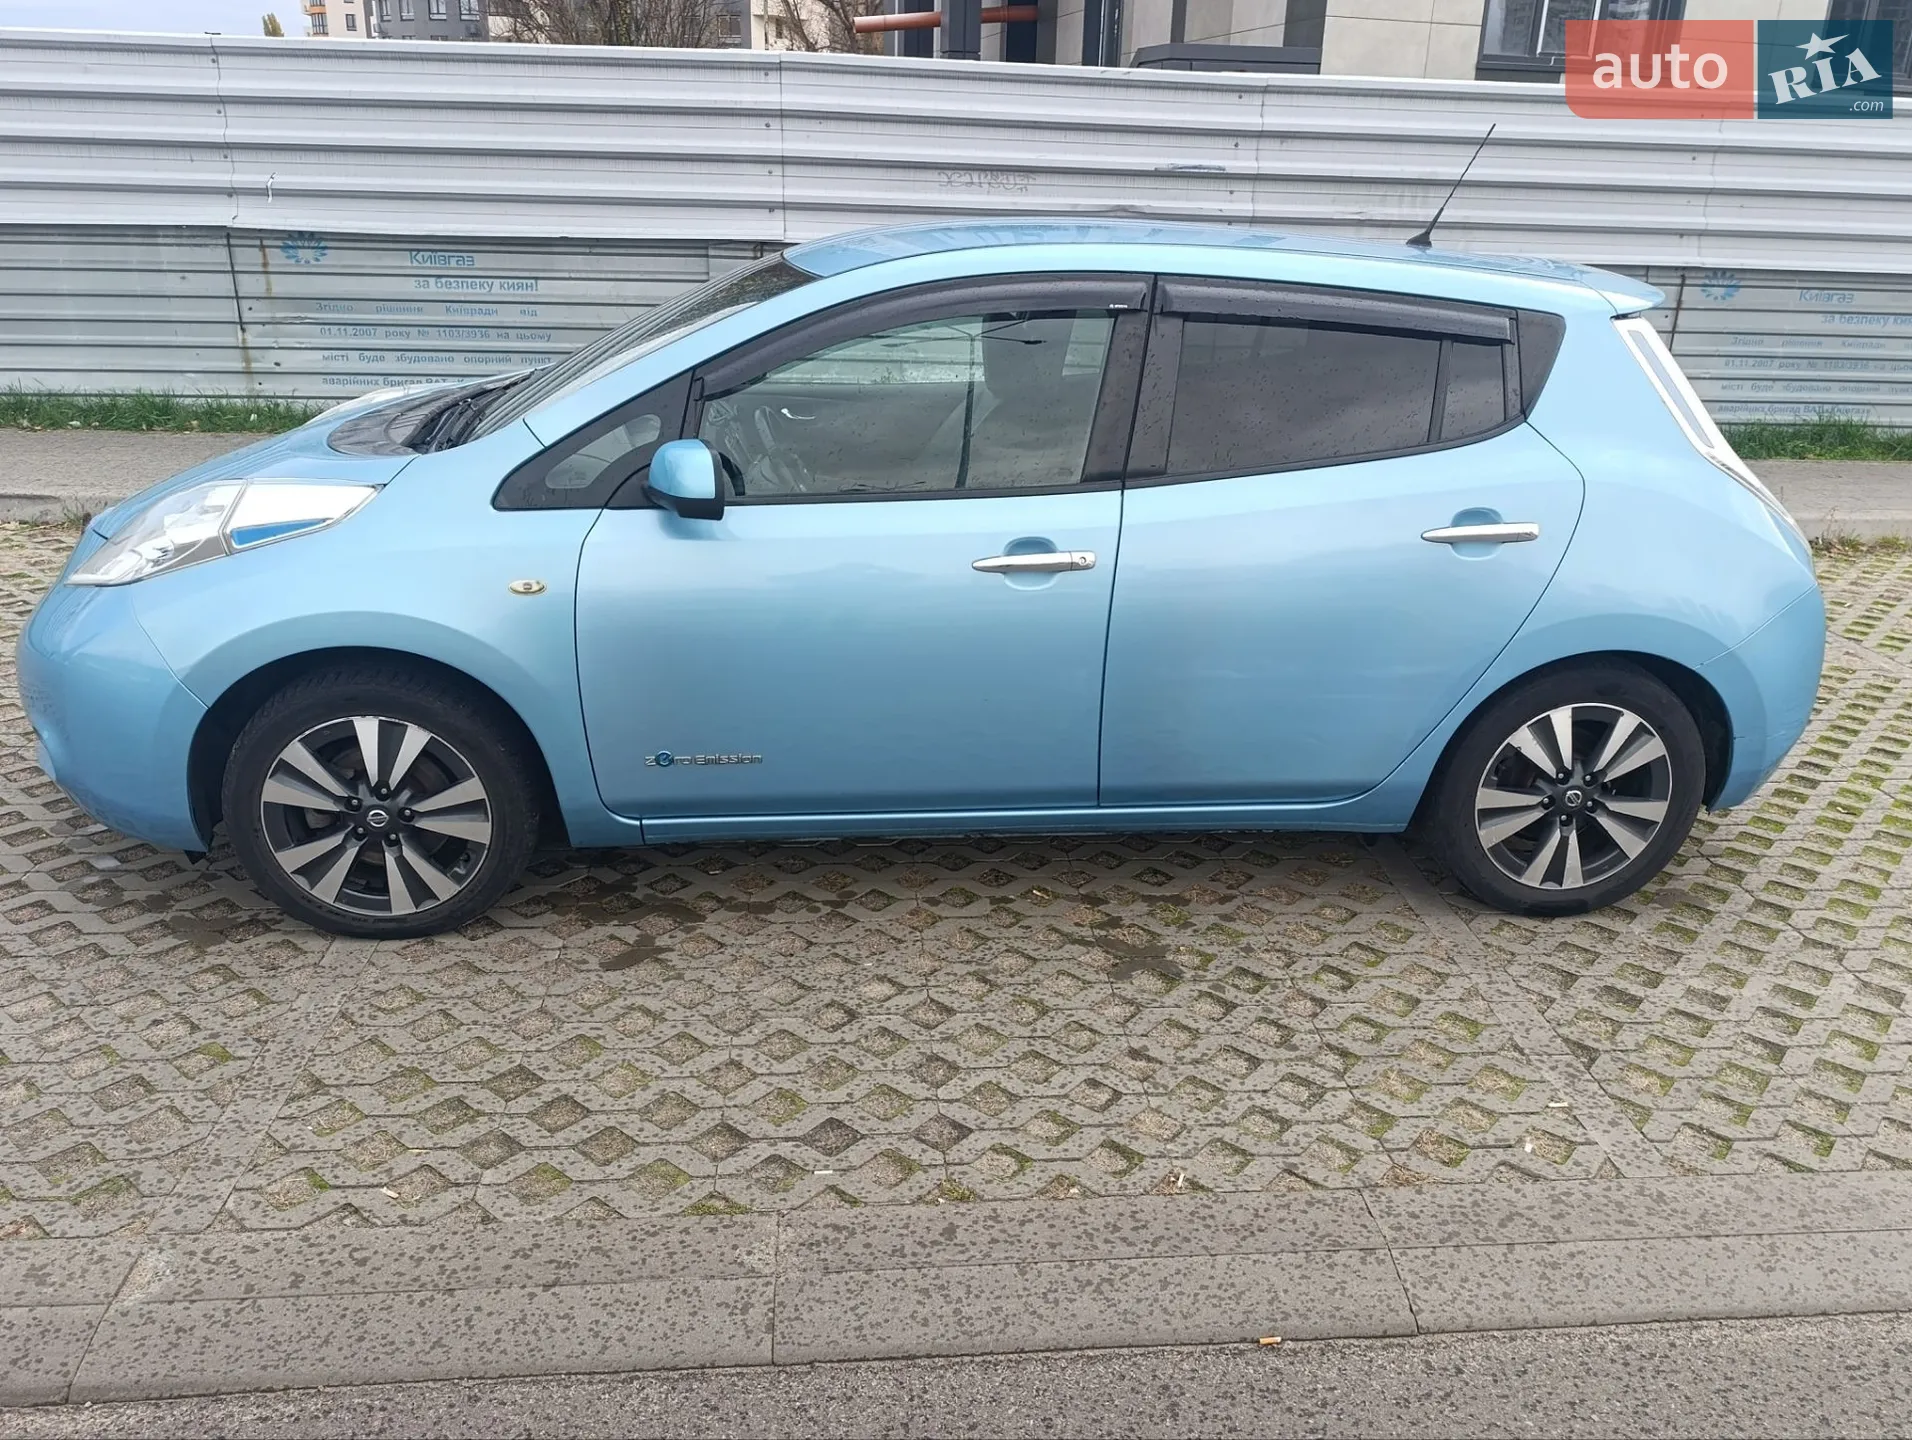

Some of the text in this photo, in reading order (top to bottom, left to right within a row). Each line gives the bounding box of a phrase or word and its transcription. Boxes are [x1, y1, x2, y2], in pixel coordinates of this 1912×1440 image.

[409, 250, 475, 267] Київгаз
[414, 277, 539, 293] за безпеку киян!
[1799, 289, 1855, 304] Київгаз
[320, 327, 378, 337] 01.11.2007
[384, 329, 411, 339] року
[417, 329, 430, 337] №
[496, 331, 510, 340] на
[516, 332, 552, 342] цьому
[322, 353, 349, 362] місті
[358, 352, 386, 364] буде
[463, 355, 512, 366] опорний
[521, 357, 552, 365] пункт
